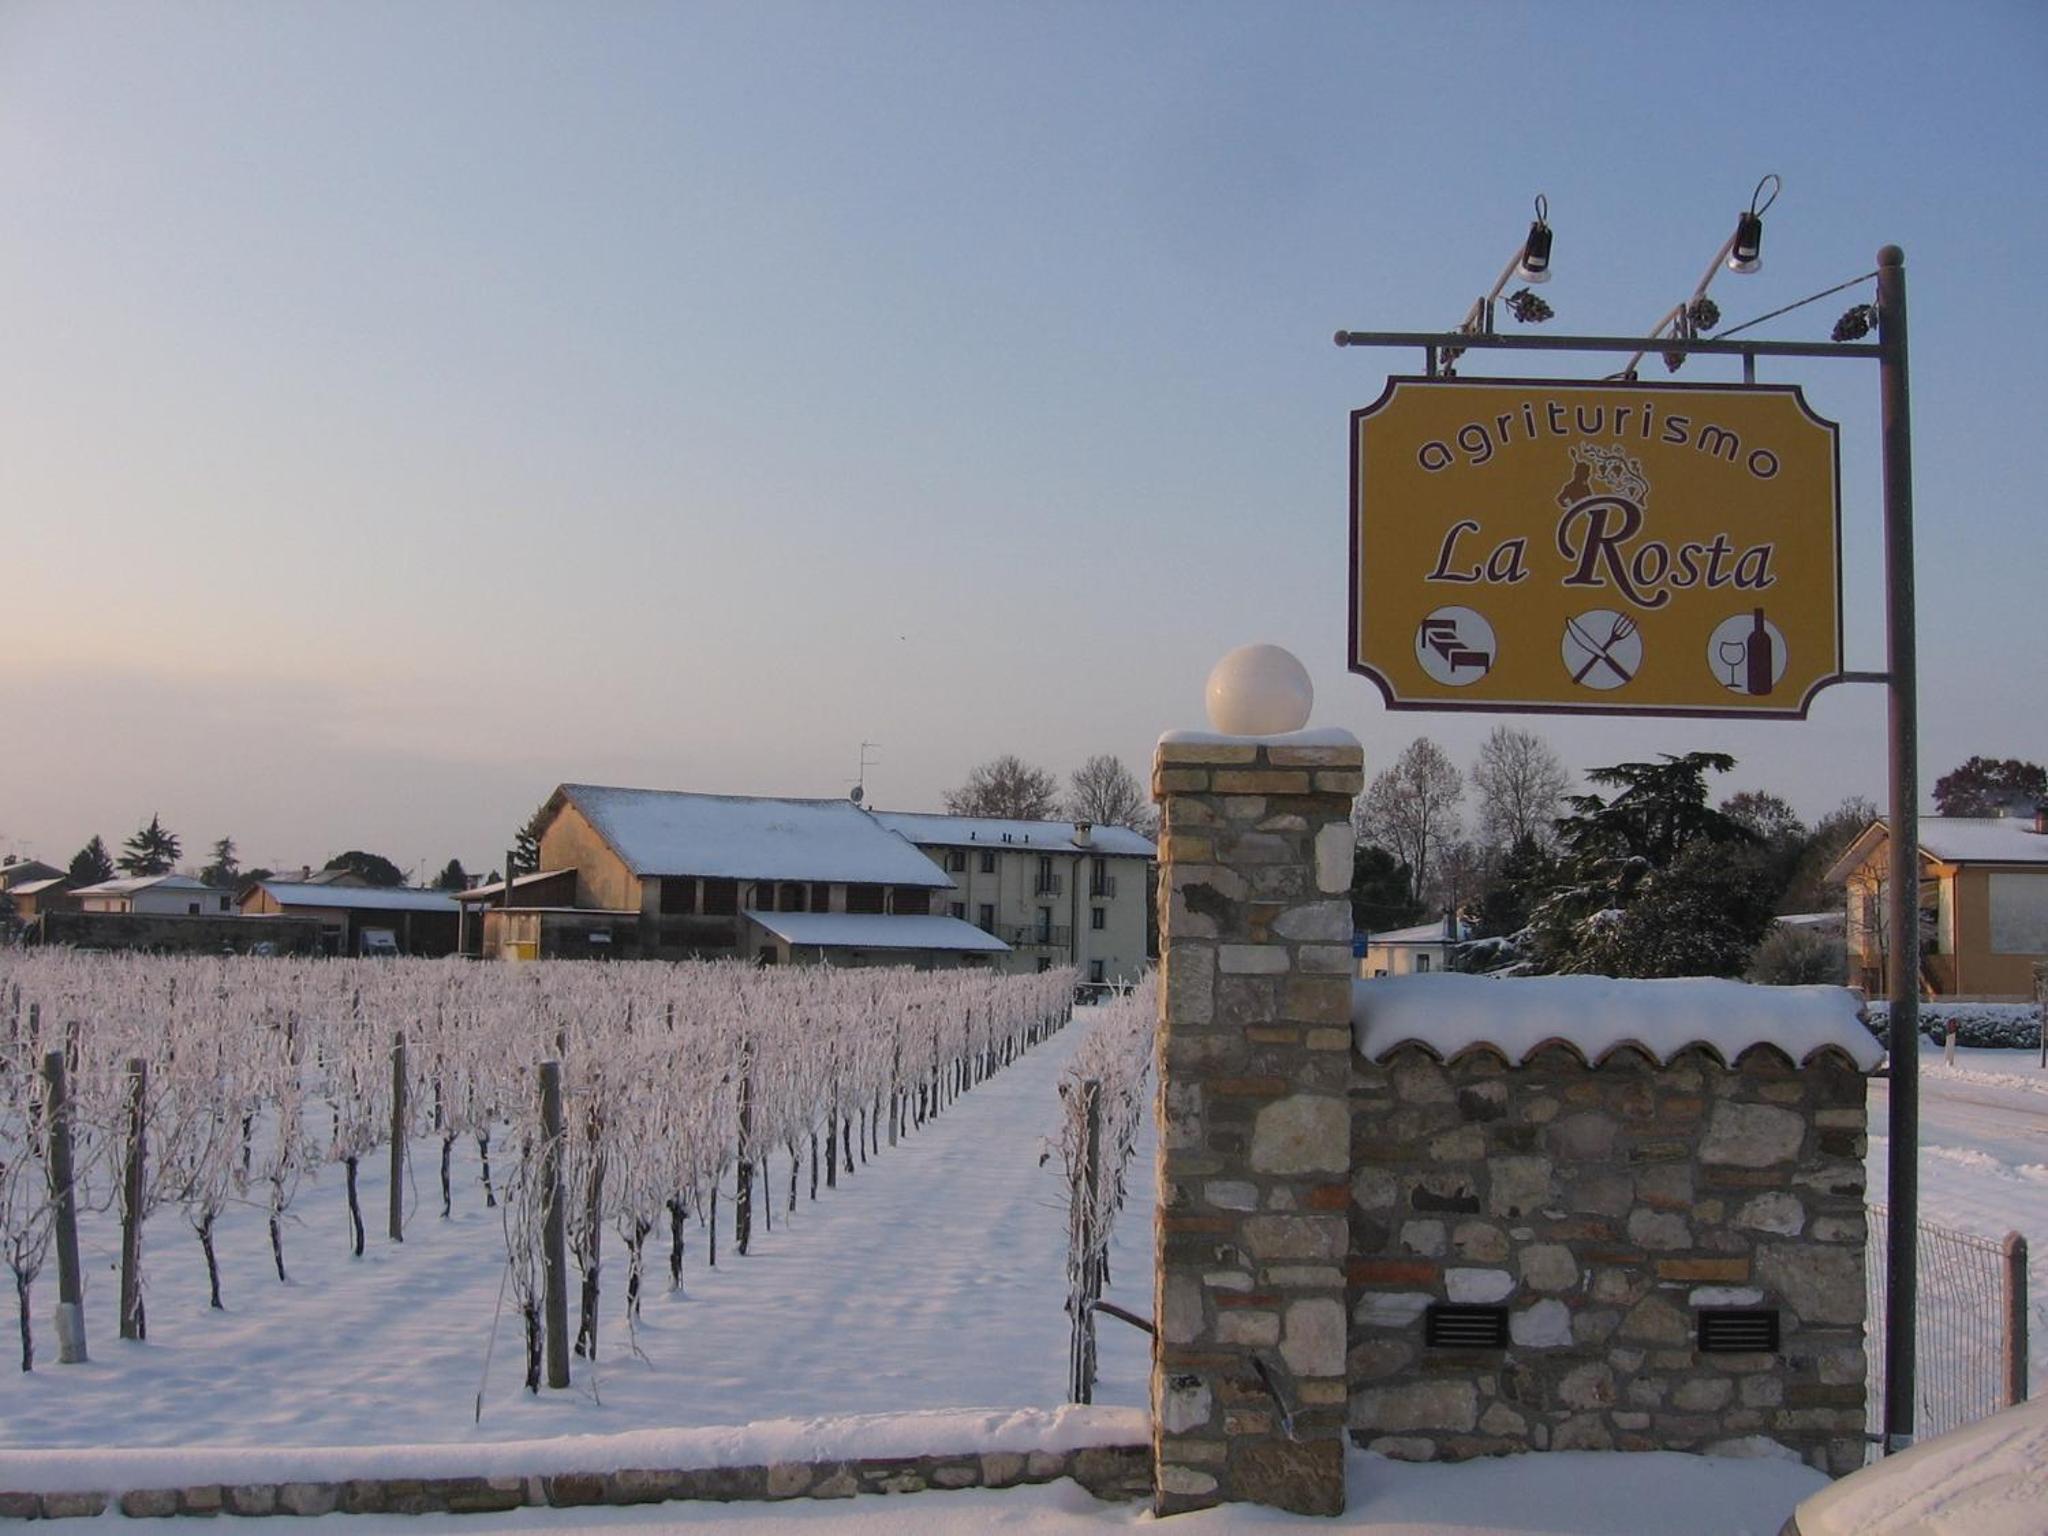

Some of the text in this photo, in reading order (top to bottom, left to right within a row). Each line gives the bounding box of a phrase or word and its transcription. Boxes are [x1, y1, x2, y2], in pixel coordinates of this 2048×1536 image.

[1418, 402, 1779, 479] agriturismo
[1426, 496, 1776, 609] La Rosta
